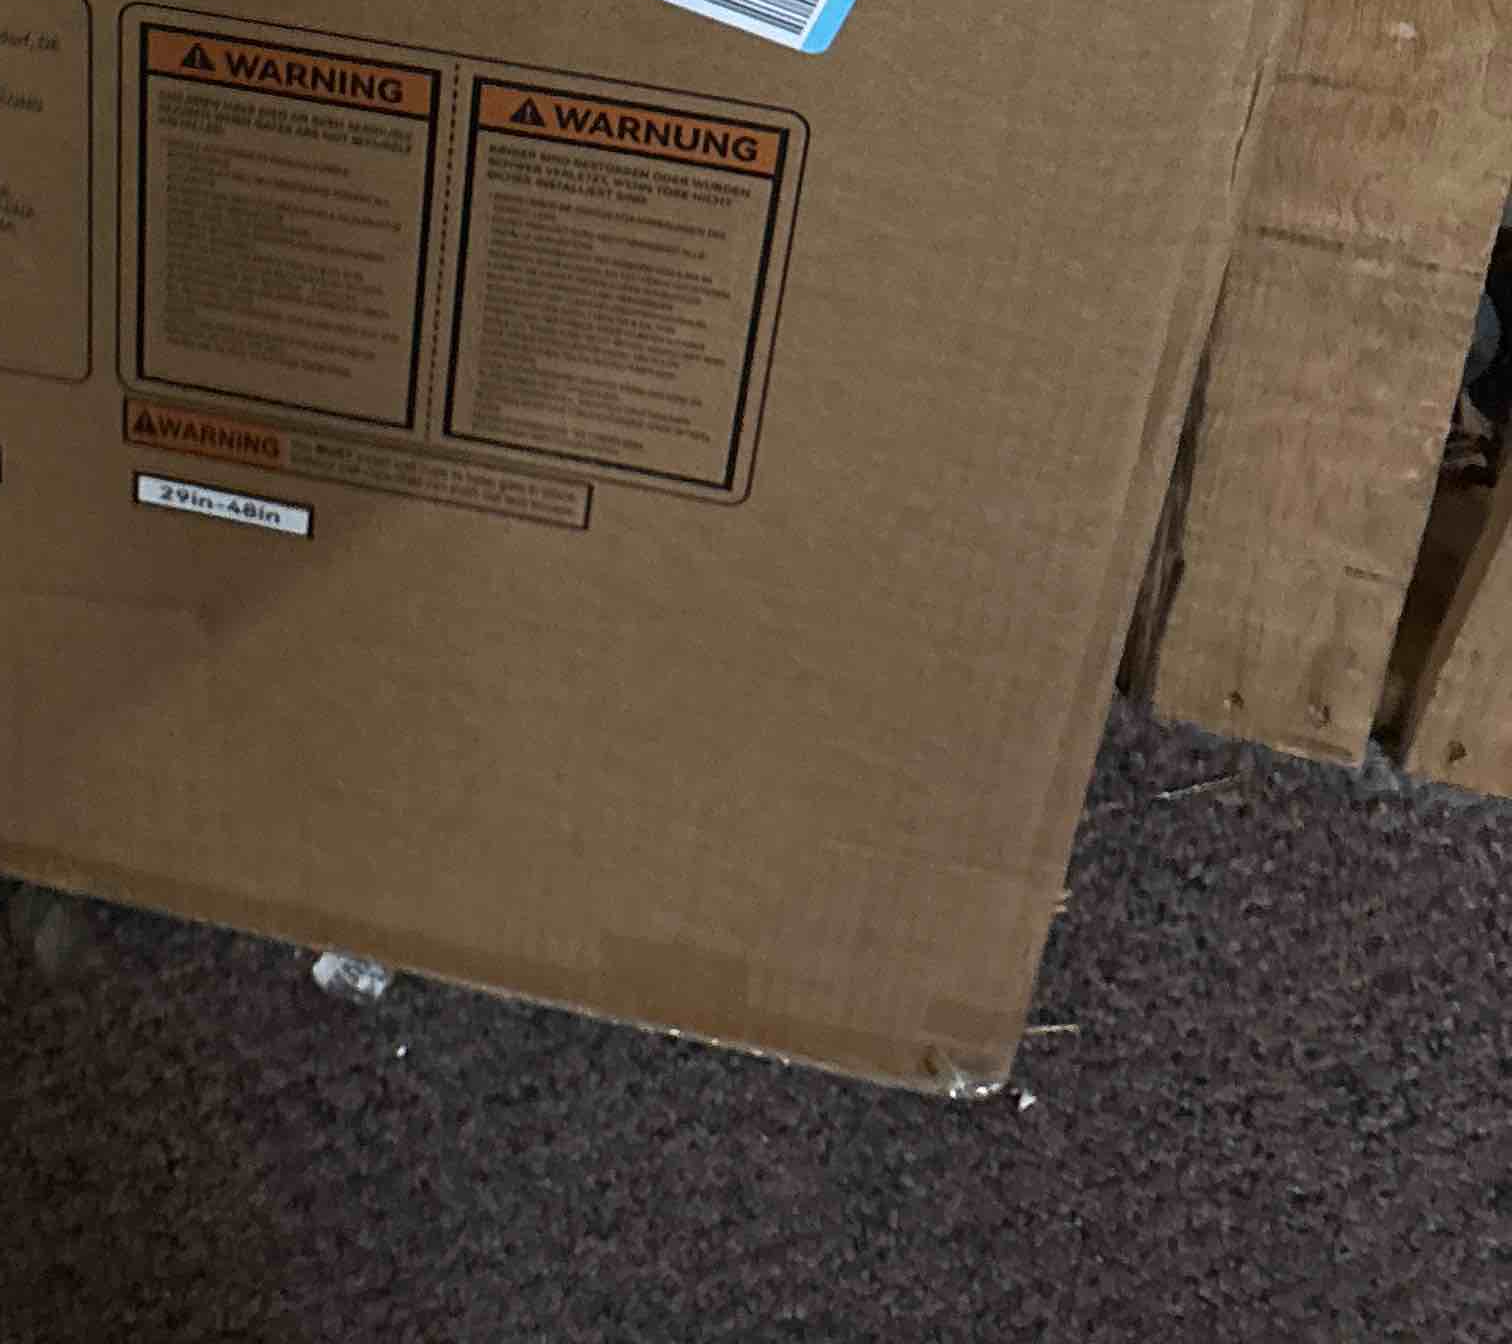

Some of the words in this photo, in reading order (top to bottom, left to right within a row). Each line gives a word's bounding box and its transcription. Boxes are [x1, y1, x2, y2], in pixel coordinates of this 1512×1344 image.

[223, 49, 404, 105] WARNING
[553, 103, 759, 164] WARNUNG
[156, 416, 283, 459] WARNING
[159, 484, 283, 525] 29in-48in
